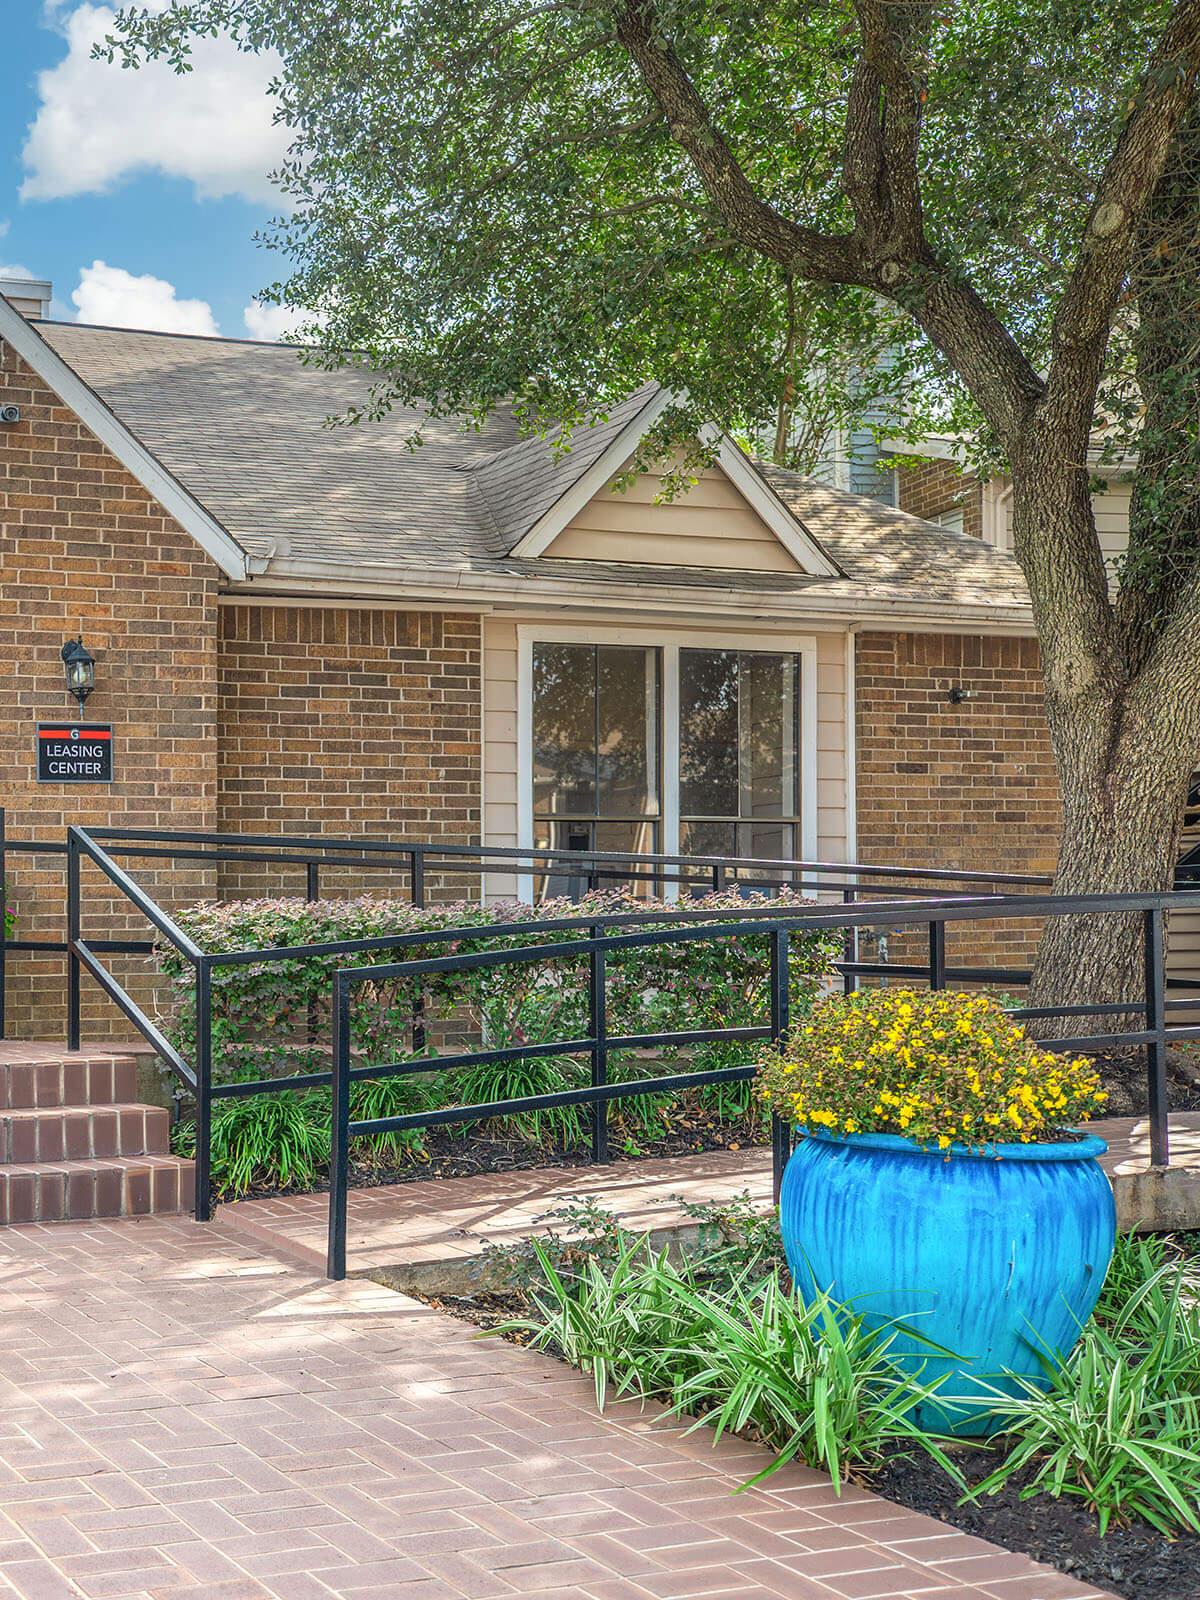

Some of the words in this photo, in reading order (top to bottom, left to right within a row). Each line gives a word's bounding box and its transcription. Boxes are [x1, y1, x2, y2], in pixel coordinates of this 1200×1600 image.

[70, 729, 80, 740] G
[46, 745, 103, 758] LEASING
[48, 762, 102, 774] CENTER
